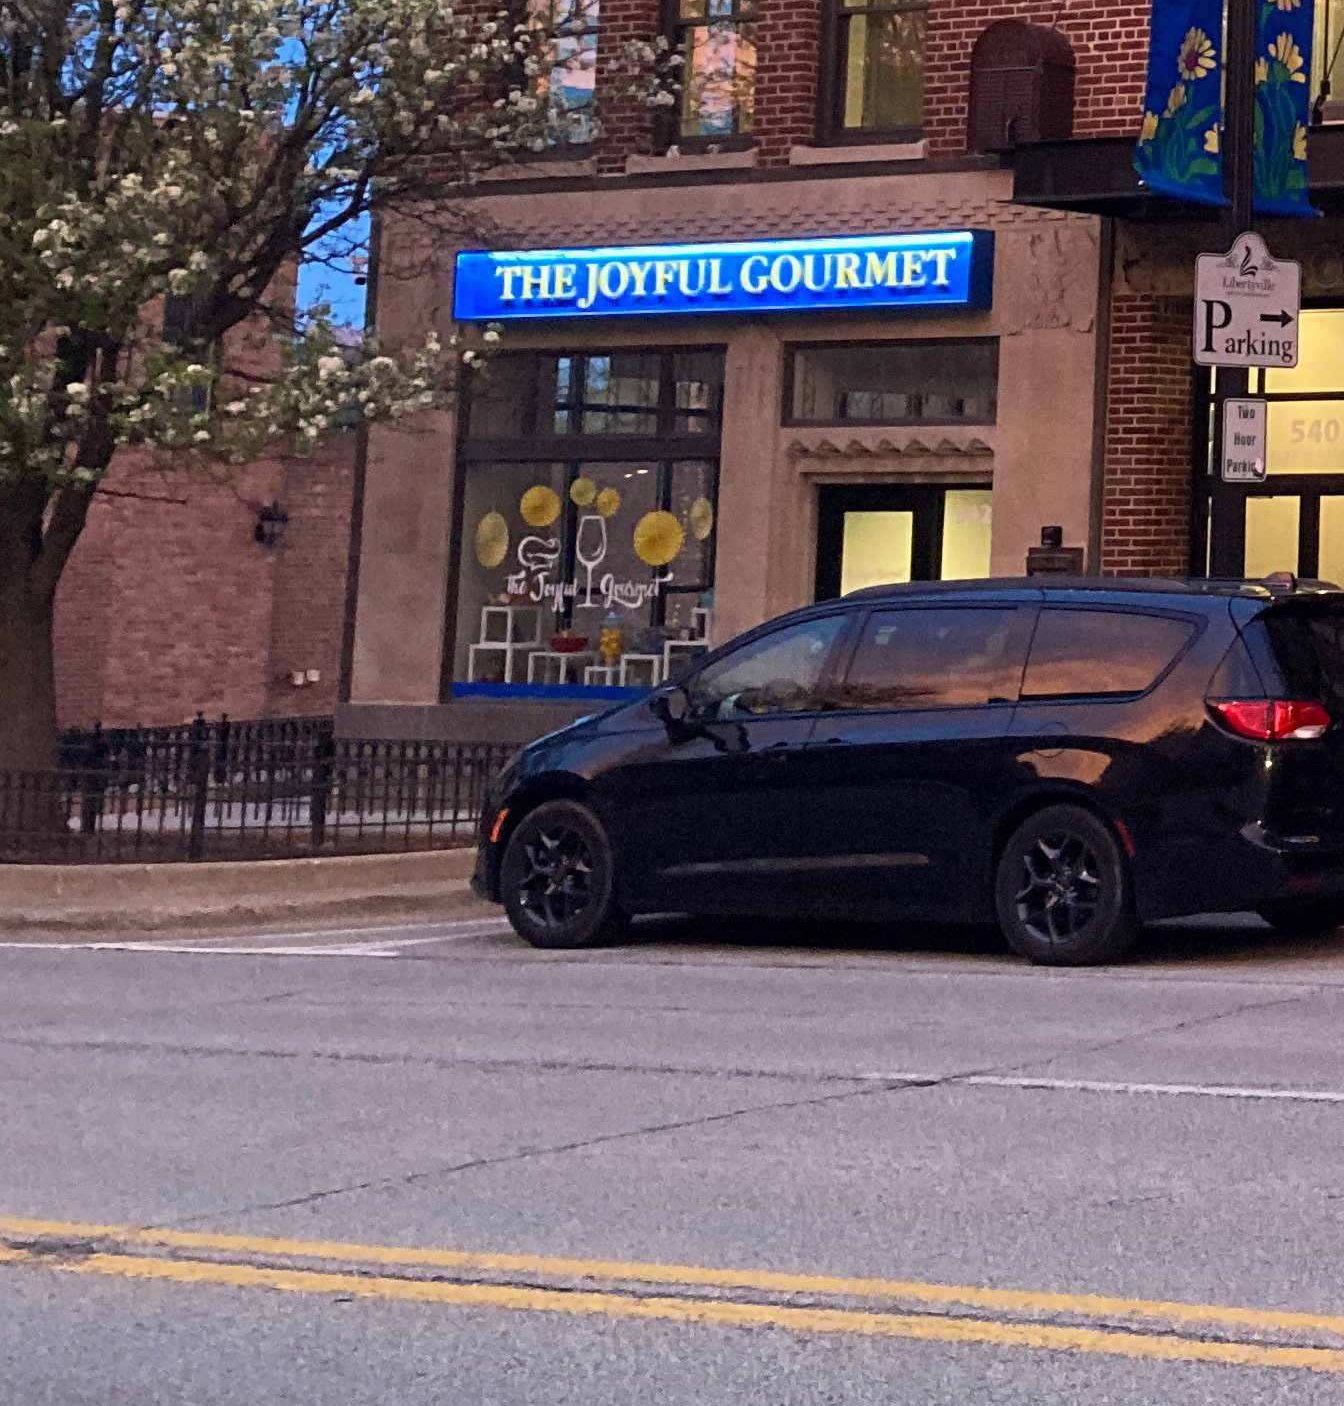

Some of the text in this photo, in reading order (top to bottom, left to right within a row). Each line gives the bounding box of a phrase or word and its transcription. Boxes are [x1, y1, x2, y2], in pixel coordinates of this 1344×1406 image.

[495, 248, 957, 309] THE JOYFUL GOURMET
[1222, 276, 1276, 292] Libertyville
[1201, 299, 1294, 364] Parking
[1237, 405, 1256, 420] Two
[1234, 432, 1256, 446] Hour
[1290, 418, 1341, 444] 540
